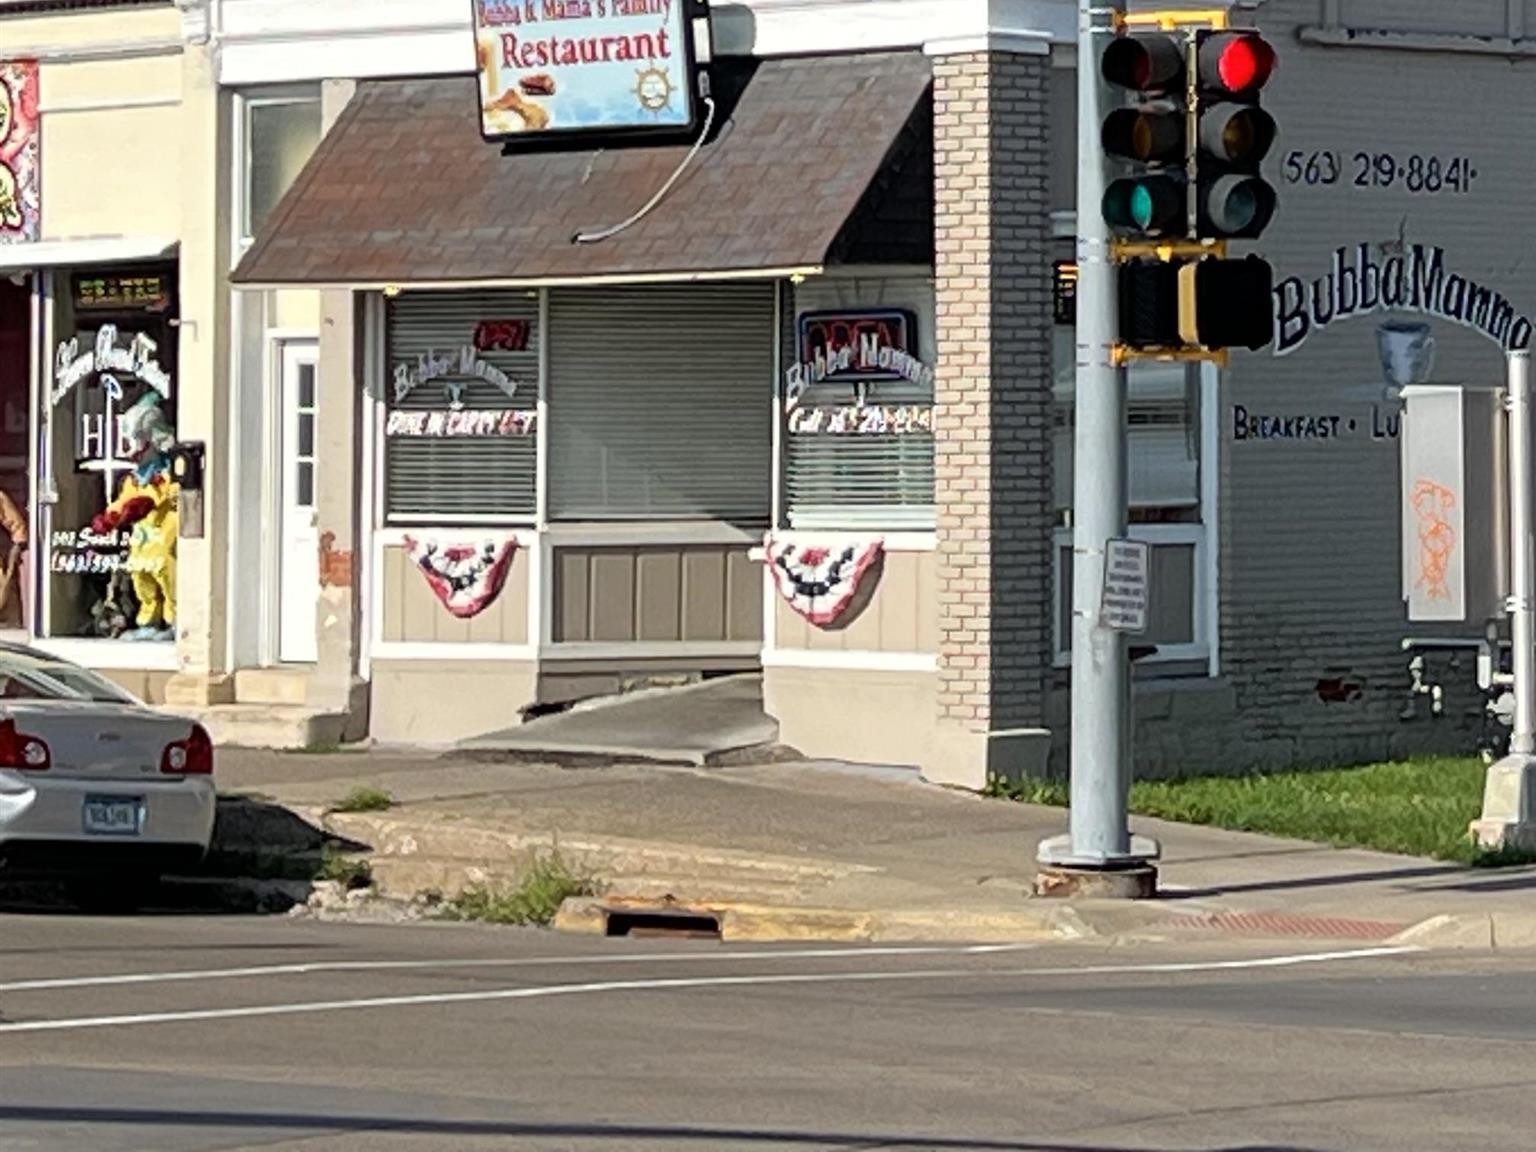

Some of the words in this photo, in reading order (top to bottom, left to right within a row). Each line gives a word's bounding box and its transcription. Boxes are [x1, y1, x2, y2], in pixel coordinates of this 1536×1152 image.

[500, 28, 672, 70] Restaurant
[1273, 242, 1404, 356] Bubba
[1234, 404, 1340, 441] BREAKFAST
